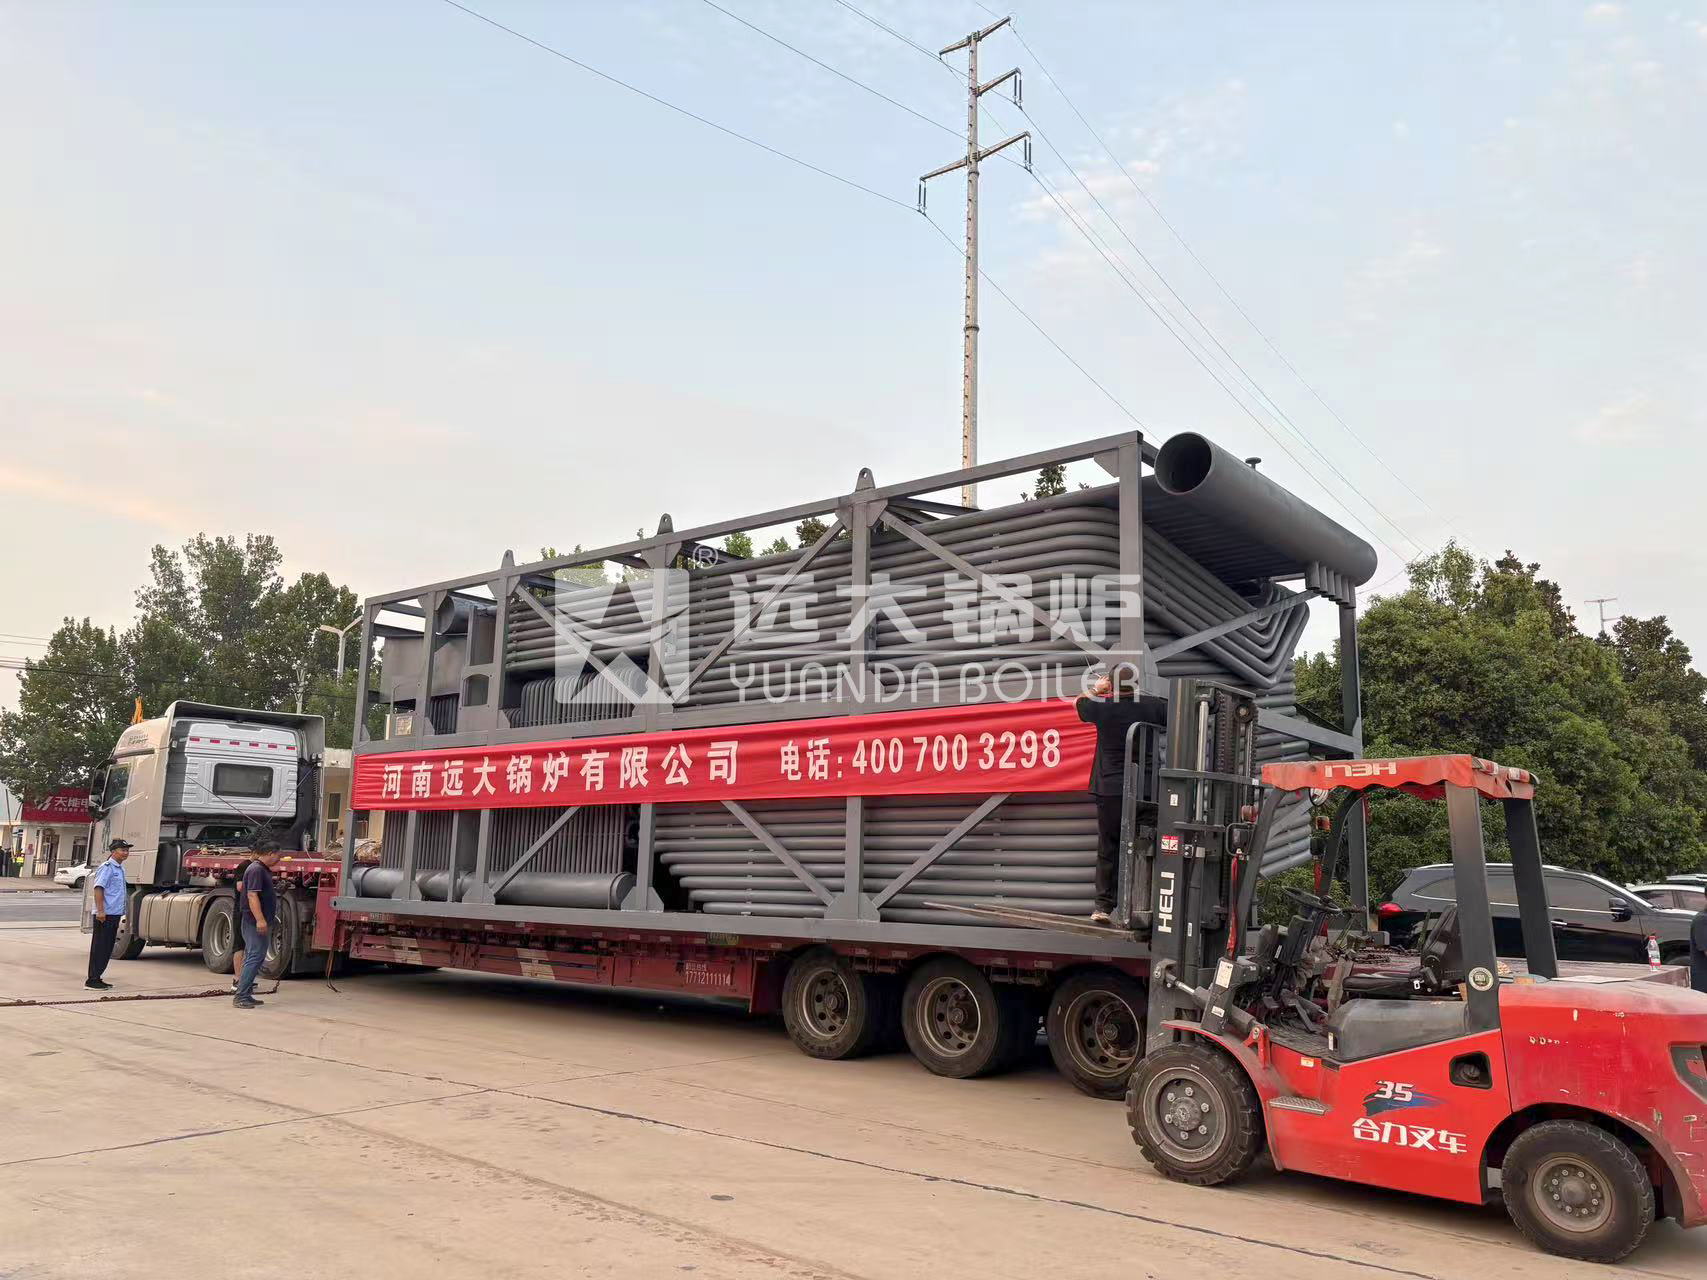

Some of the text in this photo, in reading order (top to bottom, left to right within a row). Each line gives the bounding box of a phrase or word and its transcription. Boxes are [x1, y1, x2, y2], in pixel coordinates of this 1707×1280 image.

[380, 739, 740, 800] 河南远大锅炉有限公司
[851, 737, 905, 775] 400
[912, 733, 969, 773] 700
[977, 728, 1062, 770] 3298
[1157, 871, 1175, 934] HELI
[1374, 1080, 1416, 1102] 35
[1352, 1117, 1468, 1154] 合力叉车
